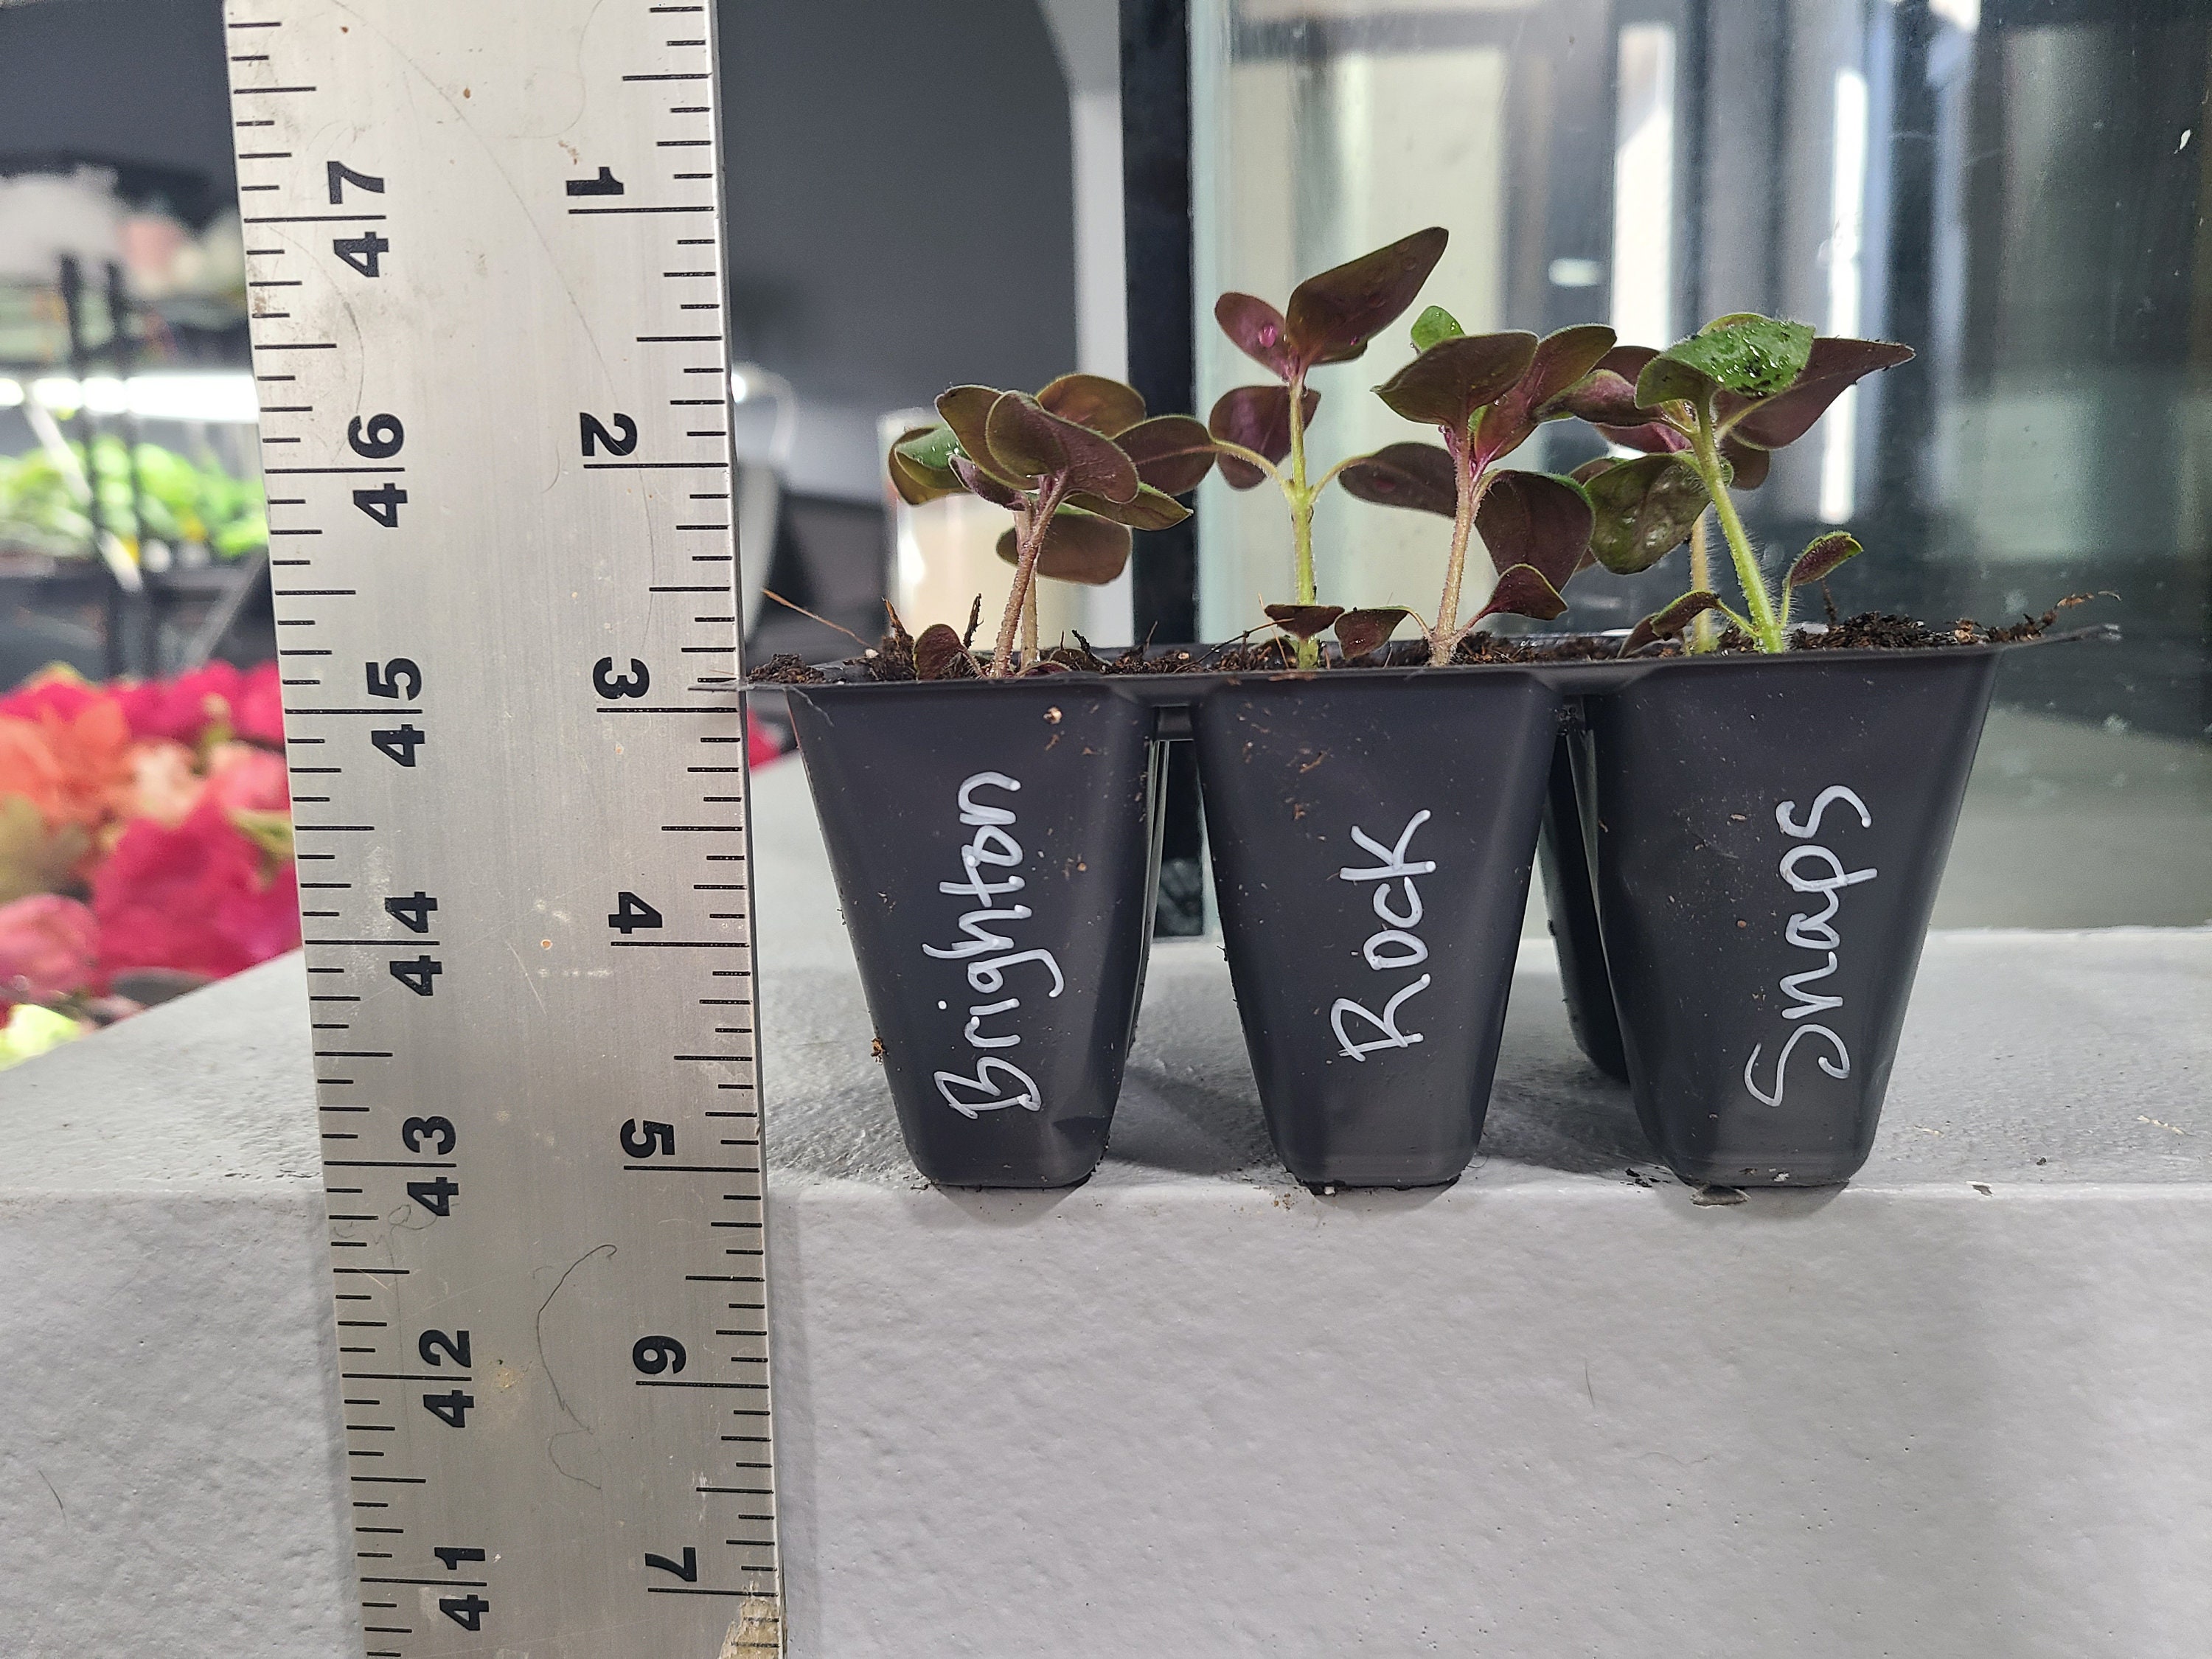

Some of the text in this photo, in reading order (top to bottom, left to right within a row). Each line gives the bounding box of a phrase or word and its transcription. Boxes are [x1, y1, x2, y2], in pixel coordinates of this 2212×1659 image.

[327, 161, 389, 277] 47
[566, 166, 625, 196] 1
[348, 413, 408, 528] 46
[580, 412, 638, 457] 2
[365, 657, 425, 768] 45
[592, 656, 650, 700] 3
[384, 891, 443, 997] 44
[608, 891, 663, 934] 4
[922, 771, 1065, 1119] Brighton
[1744, 785, 1878, 1107] Snaps
[402, 1115, 459, 1217] 43
[619, 1118, 675, 1159] 5
[418, 1329, 475, 1429] 42
[632, 1335, 687, 1377] 6
[434, 1546, 490, 1632] 41
[644, 1546, 698, 1583] 7
